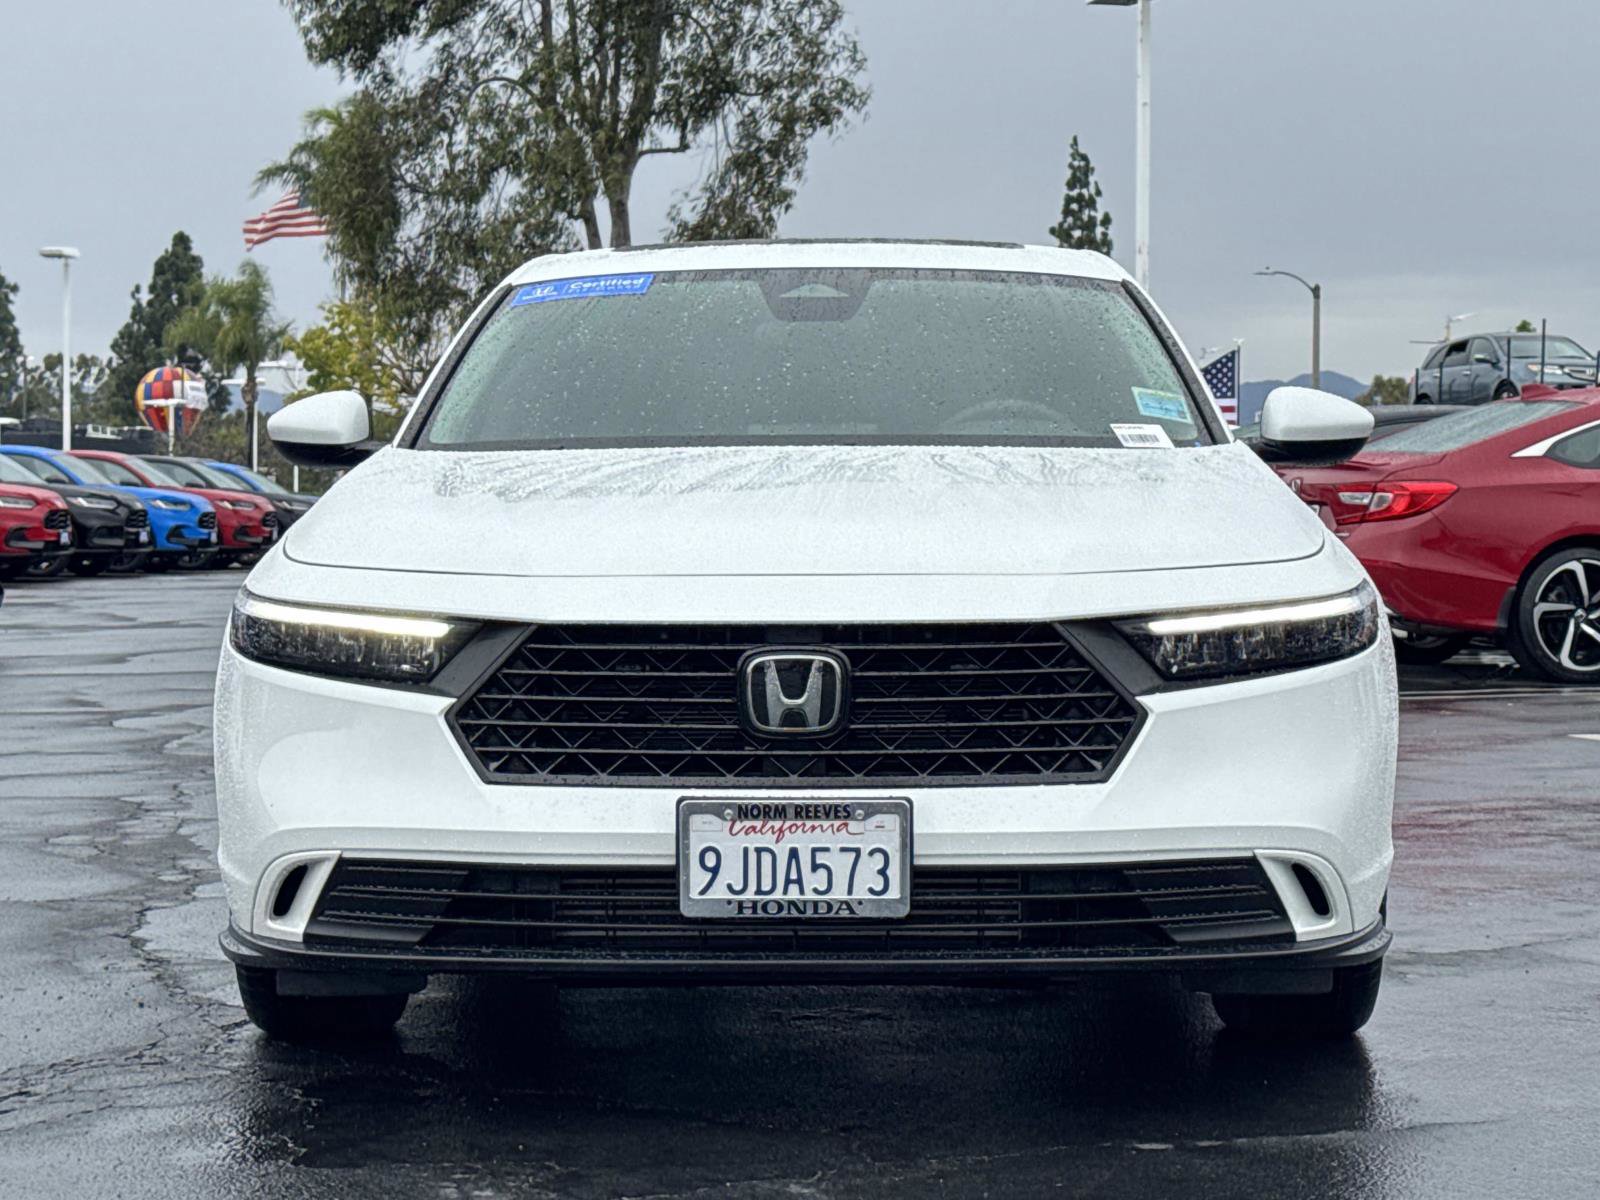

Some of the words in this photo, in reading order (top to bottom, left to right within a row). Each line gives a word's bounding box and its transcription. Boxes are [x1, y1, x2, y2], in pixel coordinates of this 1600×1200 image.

[737, 803, 787, 819] NORM
[794, 803, 851, 819] REEVES
[728, 819, 865, 844] California
[698, 845, 890, 897] 9JDA573
[735, 900, 859, 915] HONDA
